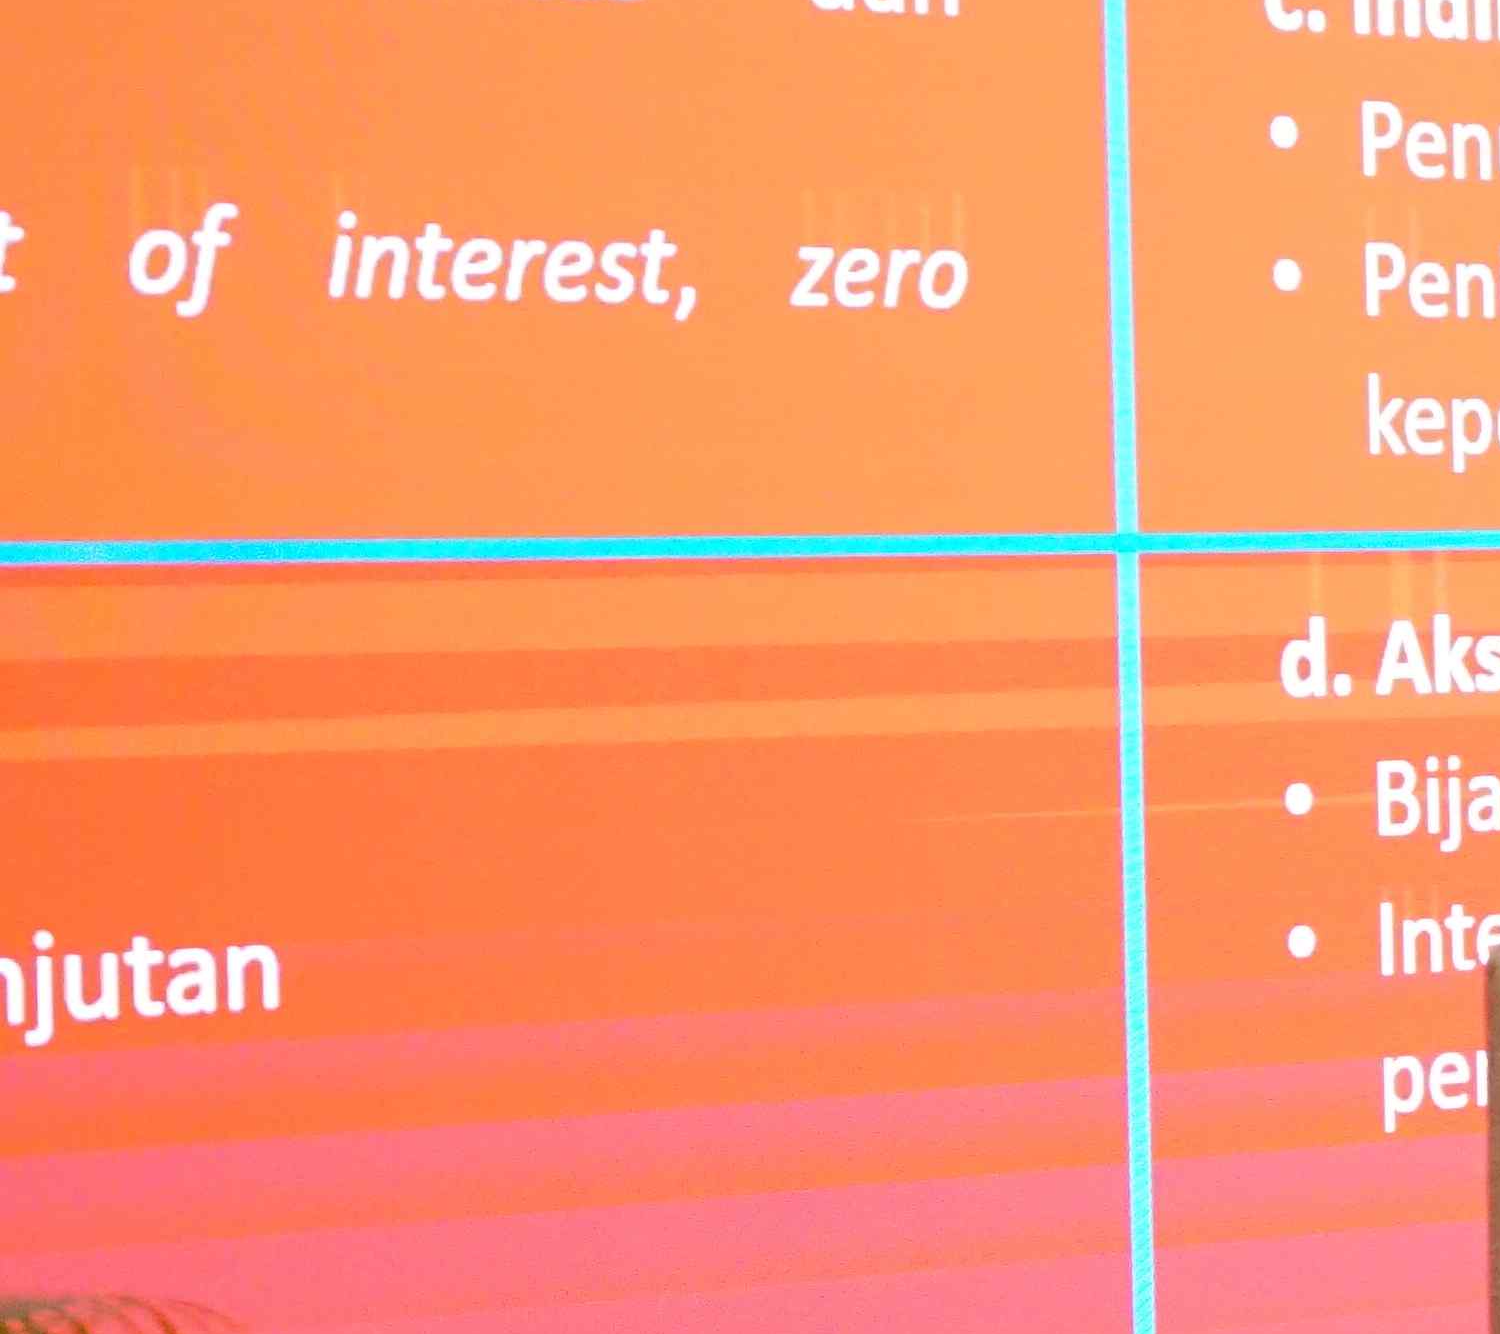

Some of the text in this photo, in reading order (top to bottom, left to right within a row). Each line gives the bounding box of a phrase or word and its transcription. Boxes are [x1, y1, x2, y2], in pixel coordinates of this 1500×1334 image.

[128, 201, 240, 318] of
[327, 209, 698, 323] interest,
[788, 245, 970, 311] zero
[1279, 614, 1353, 700] d.
